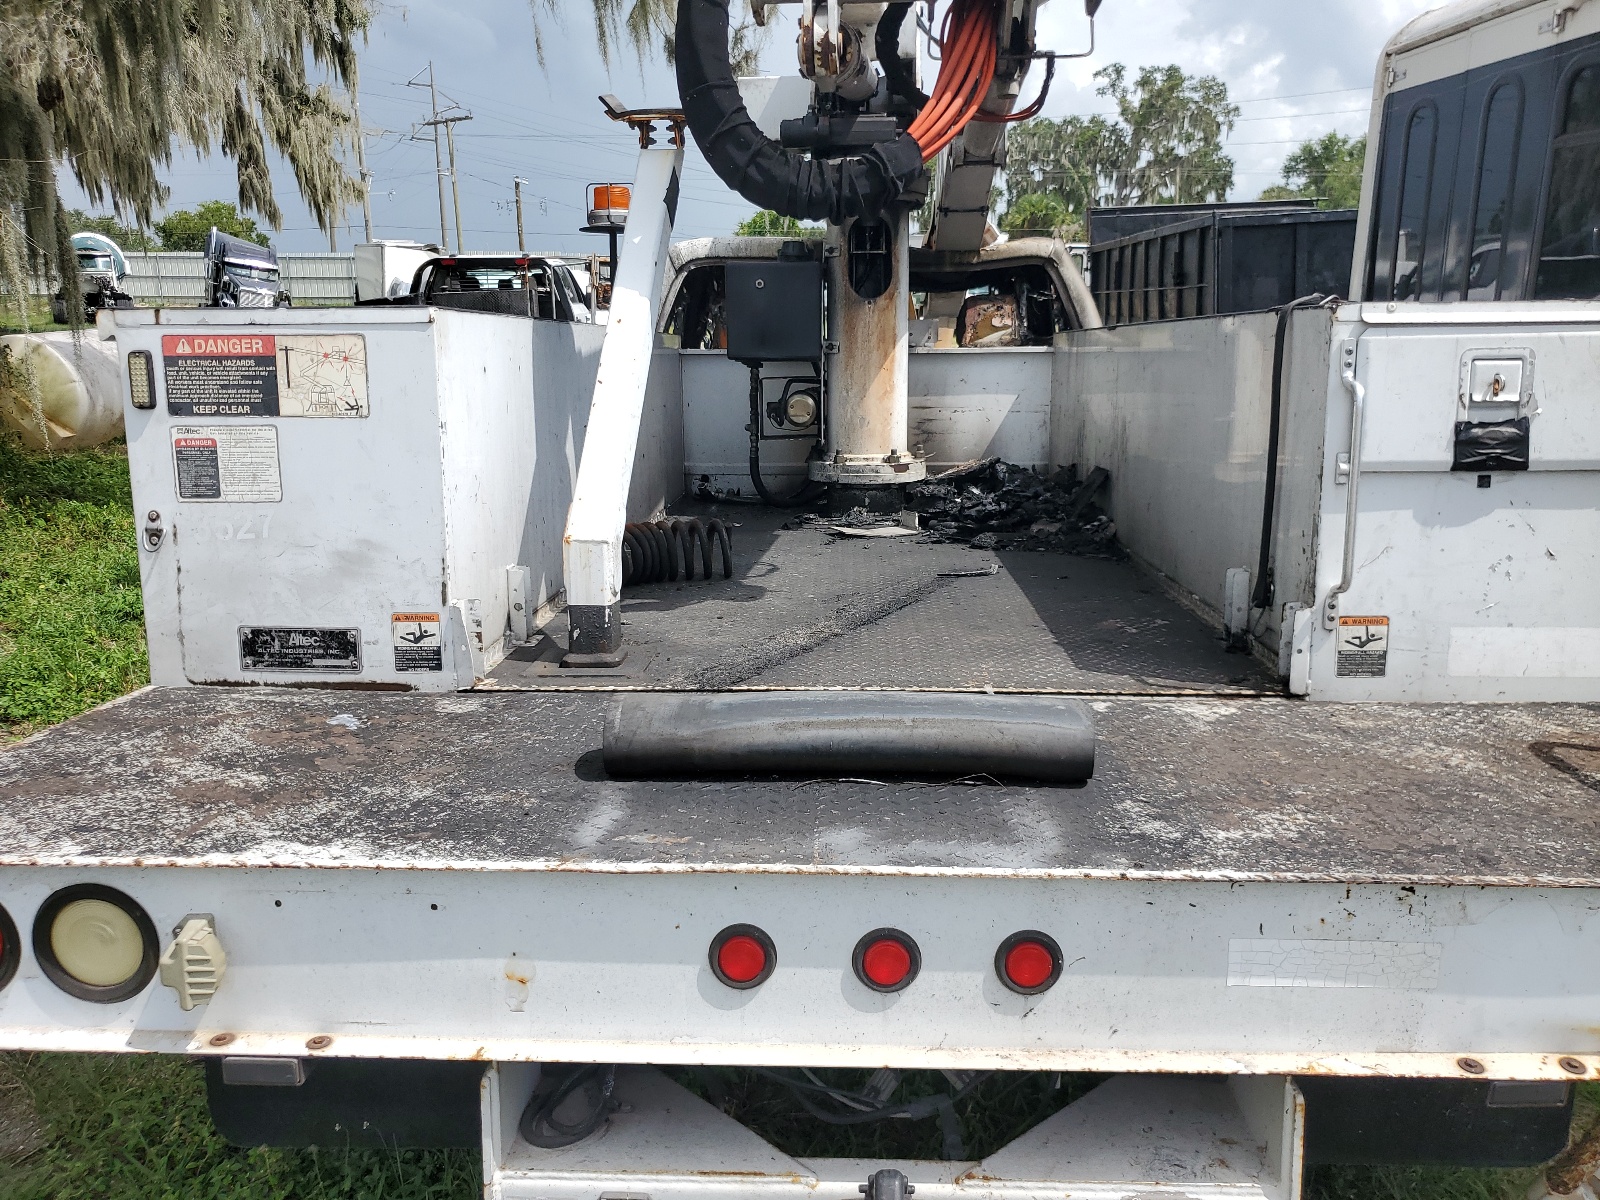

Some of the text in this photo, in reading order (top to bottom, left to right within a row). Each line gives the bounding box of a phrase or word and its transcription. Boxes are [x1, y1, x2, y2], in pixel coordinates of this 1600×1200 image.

[194, 339, 263, 353] DANGER
[178, 359, 256, 367] ELECTRICAL HAZARDS
[193, 405, 251, 414] KEEP CLEAR
[288, 632, 321, 646] Altec
